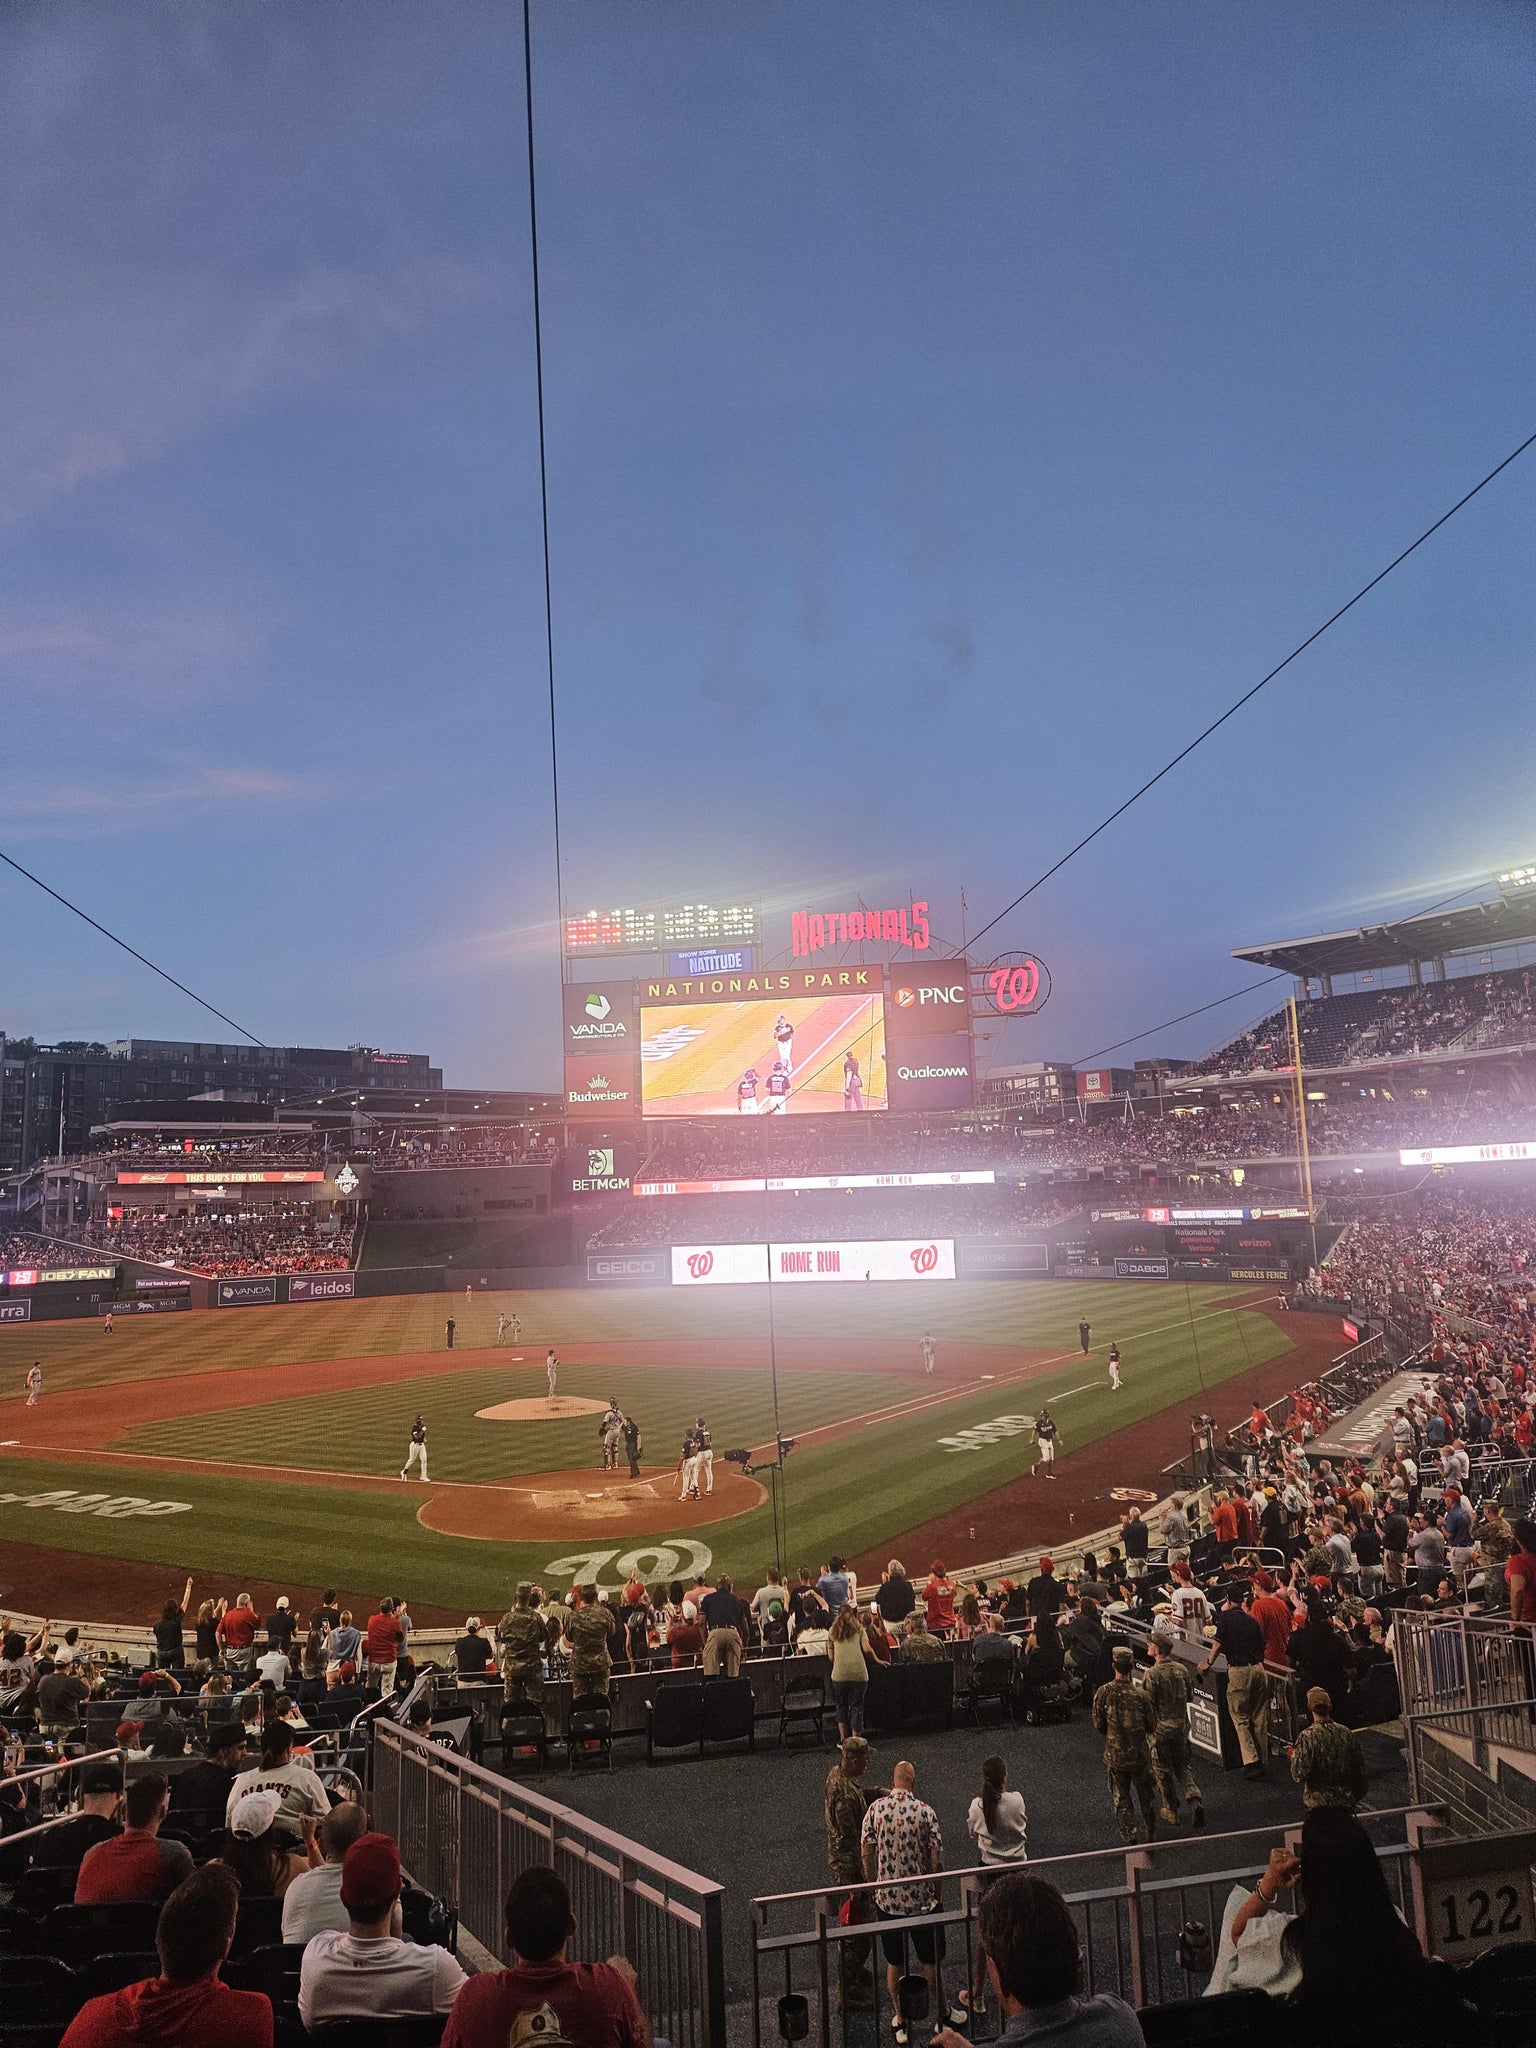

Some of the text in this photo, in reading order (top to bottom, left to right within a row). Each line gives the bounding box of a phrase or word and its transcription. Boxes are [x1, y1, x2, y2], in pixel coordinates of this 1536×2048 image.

[791, 902, 929, 957] NATIONALS
[678, 951, 698, 959] SHOW
[689, 953, 742, 974] NATITUDE
[648, 971, 869, 997] NATIONALS PARK
[918, 986, 965, 1005] PNC
[570, 1023, 627, 1035] VANDA
[898, 1066, 968, 1080] Qualcomm
[569, 1091, 629, 1102] Budweiser
[1480, 1146, 1504, 1159] HOME
[1509, 1144, 1528, 1157] RUN
[186, 1172, 266, 1182] THIS BUD'S FOR YOU.
[876, 1176, 895, 1185] HOME
[899, 1175, 913, 1184] RUN
[572, 1178, 630, 1192] BETMGM
[1209, 1228, 1226, 1236] Park
[1239, 1239, 1272, 1247] verizon
[596, 1261, 656, 1274] GEICO
[781, 1251, 840, 1273] HOME RUN
[78, 1269, 111, 1280] FAN
[1129, 1265, 1166, 1273] DABOS
[1231, 1270, 1288, 1279] HERCULES FENCE
[234, 1286, 271, 1295] VANDA
[310, 1281, 352, 1295] leidos
[1182, 1597, 1204, 1619] 20
[655, 1611, 666, 1623] 11
[1441, 1885, 1523, 1943] 122
